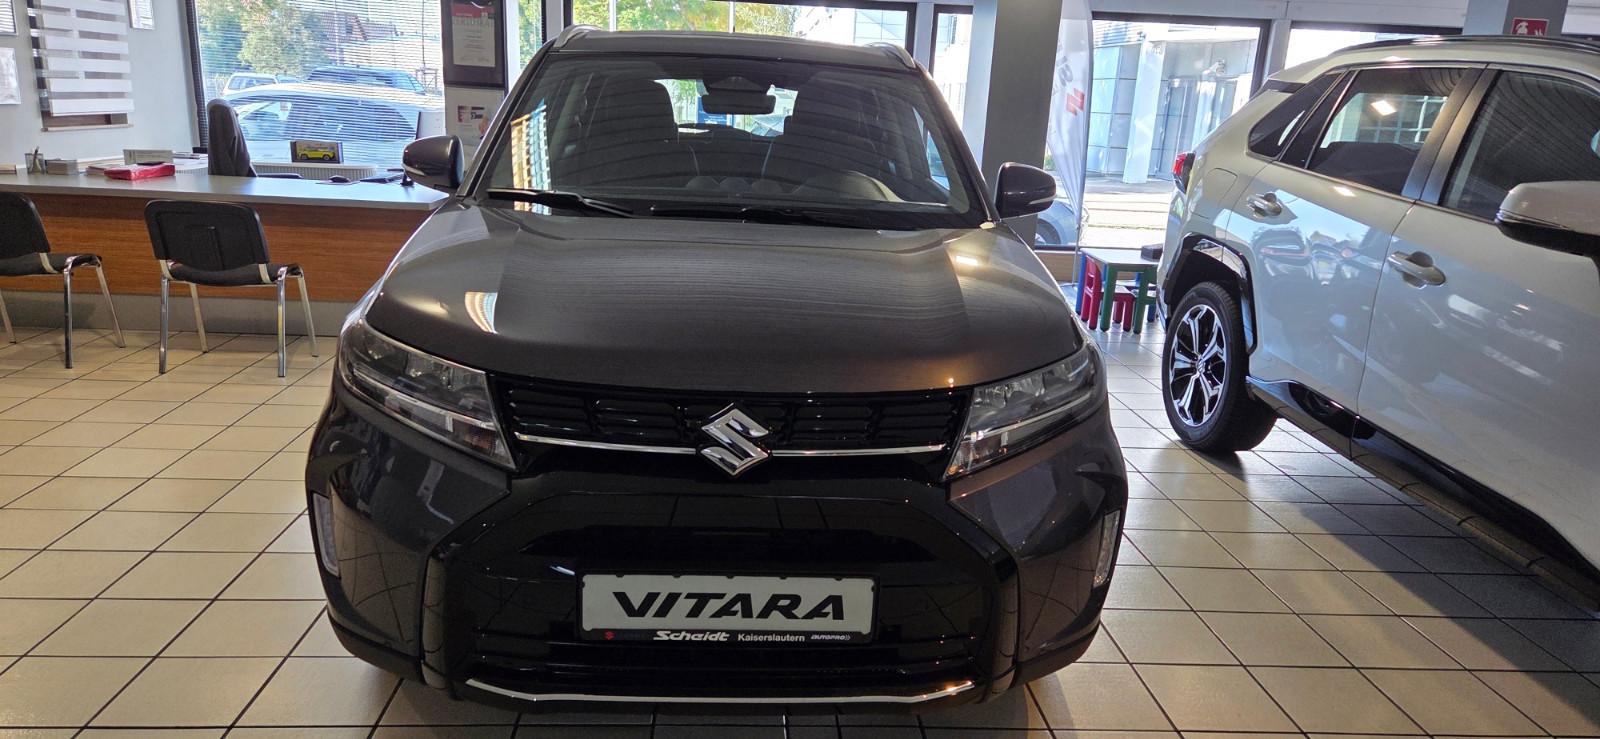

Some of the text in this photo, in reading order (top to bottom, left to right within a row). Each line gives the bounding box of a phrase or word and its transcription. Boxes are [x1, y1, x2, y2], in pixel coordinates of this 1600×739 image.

[612, 591, 845, 620] VITARA
[653, 630, 730, 642] Scheidt
[737, 633, 805, 642] Kaiserslautern
